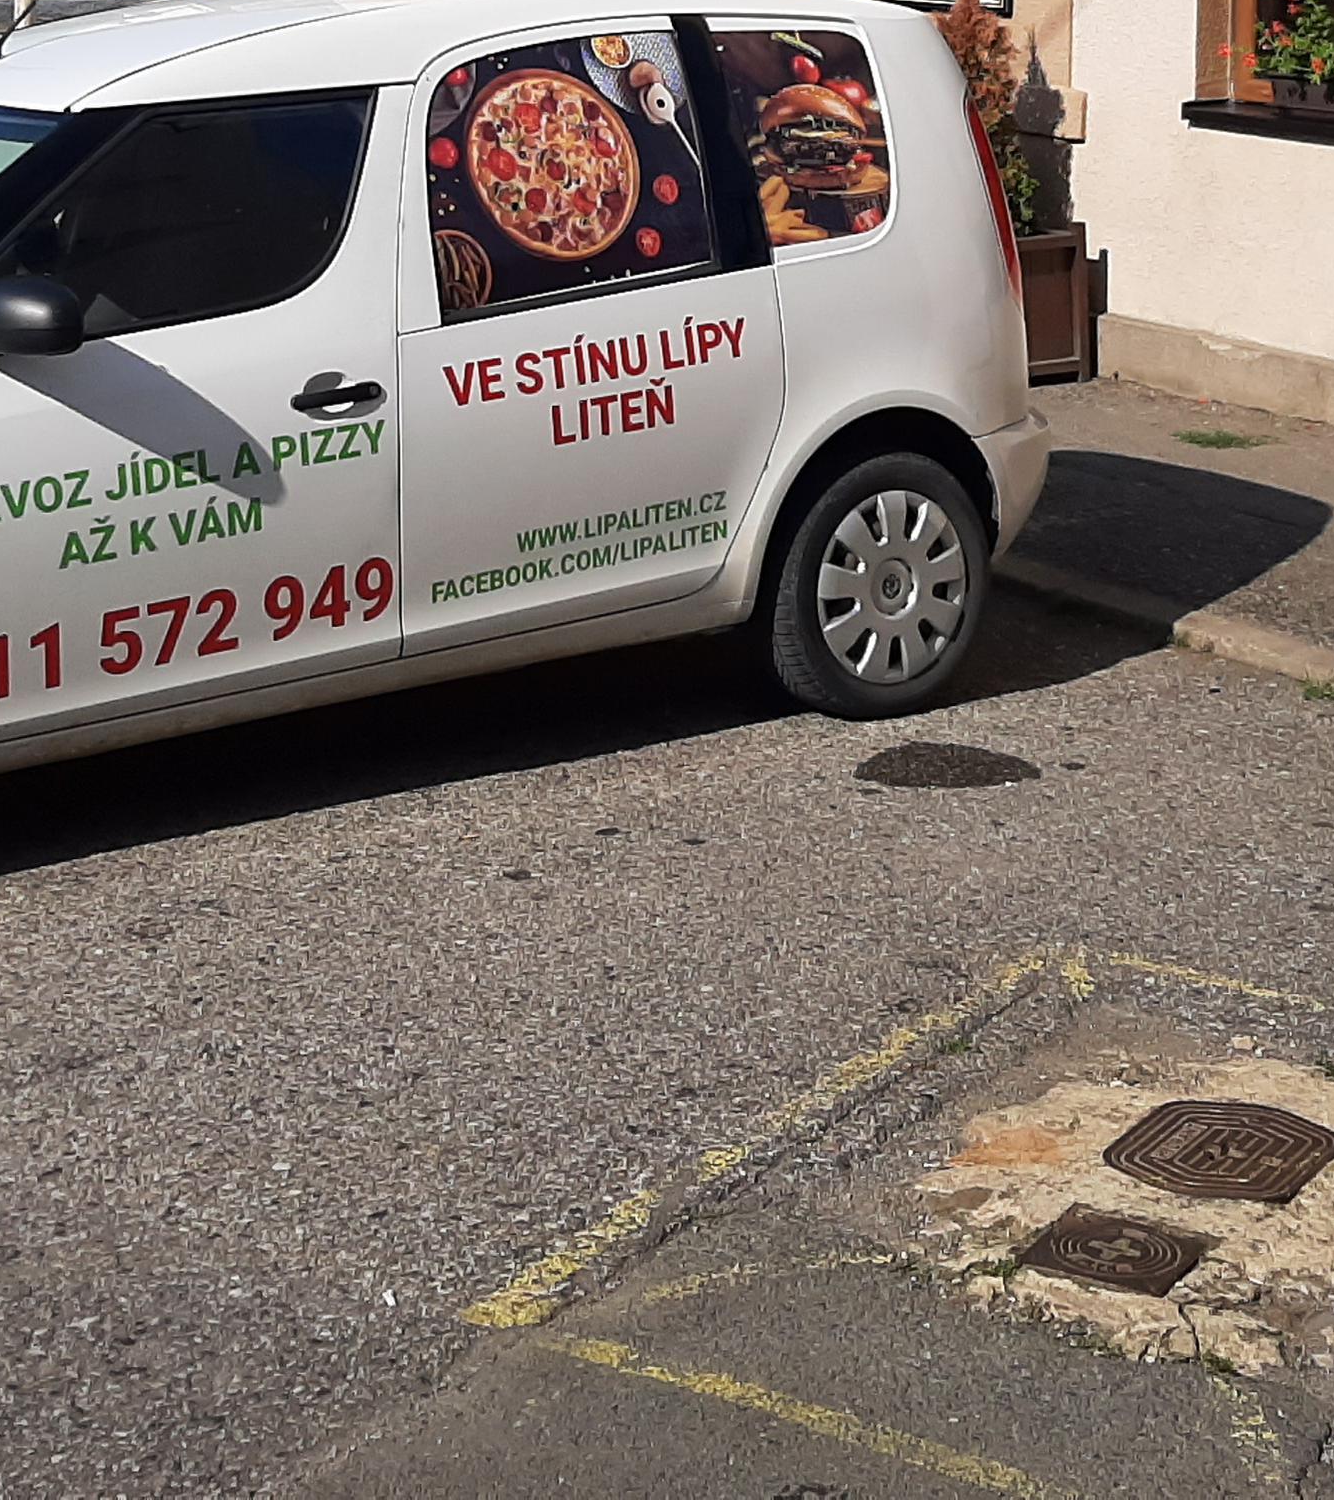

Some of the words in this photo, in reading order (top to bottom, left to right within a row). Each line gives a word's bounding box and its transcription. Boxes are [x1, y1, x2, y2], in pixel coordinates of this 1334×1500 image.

[442, 357, 506, 407] VE
[515, 334, 648, 395] STÍNU
[659, 316, 746, 371] LÍPY
[551, 376, 676, 446] LITEŇ
[105, 450, 220, 502] JÍDEL
[232, 441, 262, 478] A
[271, 419, 387, 471] PIZZY
[58, 516, 118, 570] AŽ
[129, 515, 158, 555] K
[168, 497, 263, 546] VÁM
[431, 519, 730, 604] FACEBOOK.COM/LIPALITEN
[516, 490, 728, 553] WWW.LIPALITEN.CZ
[98, 587, 239, 676] 572
[263, 556, 394, 642] 949
